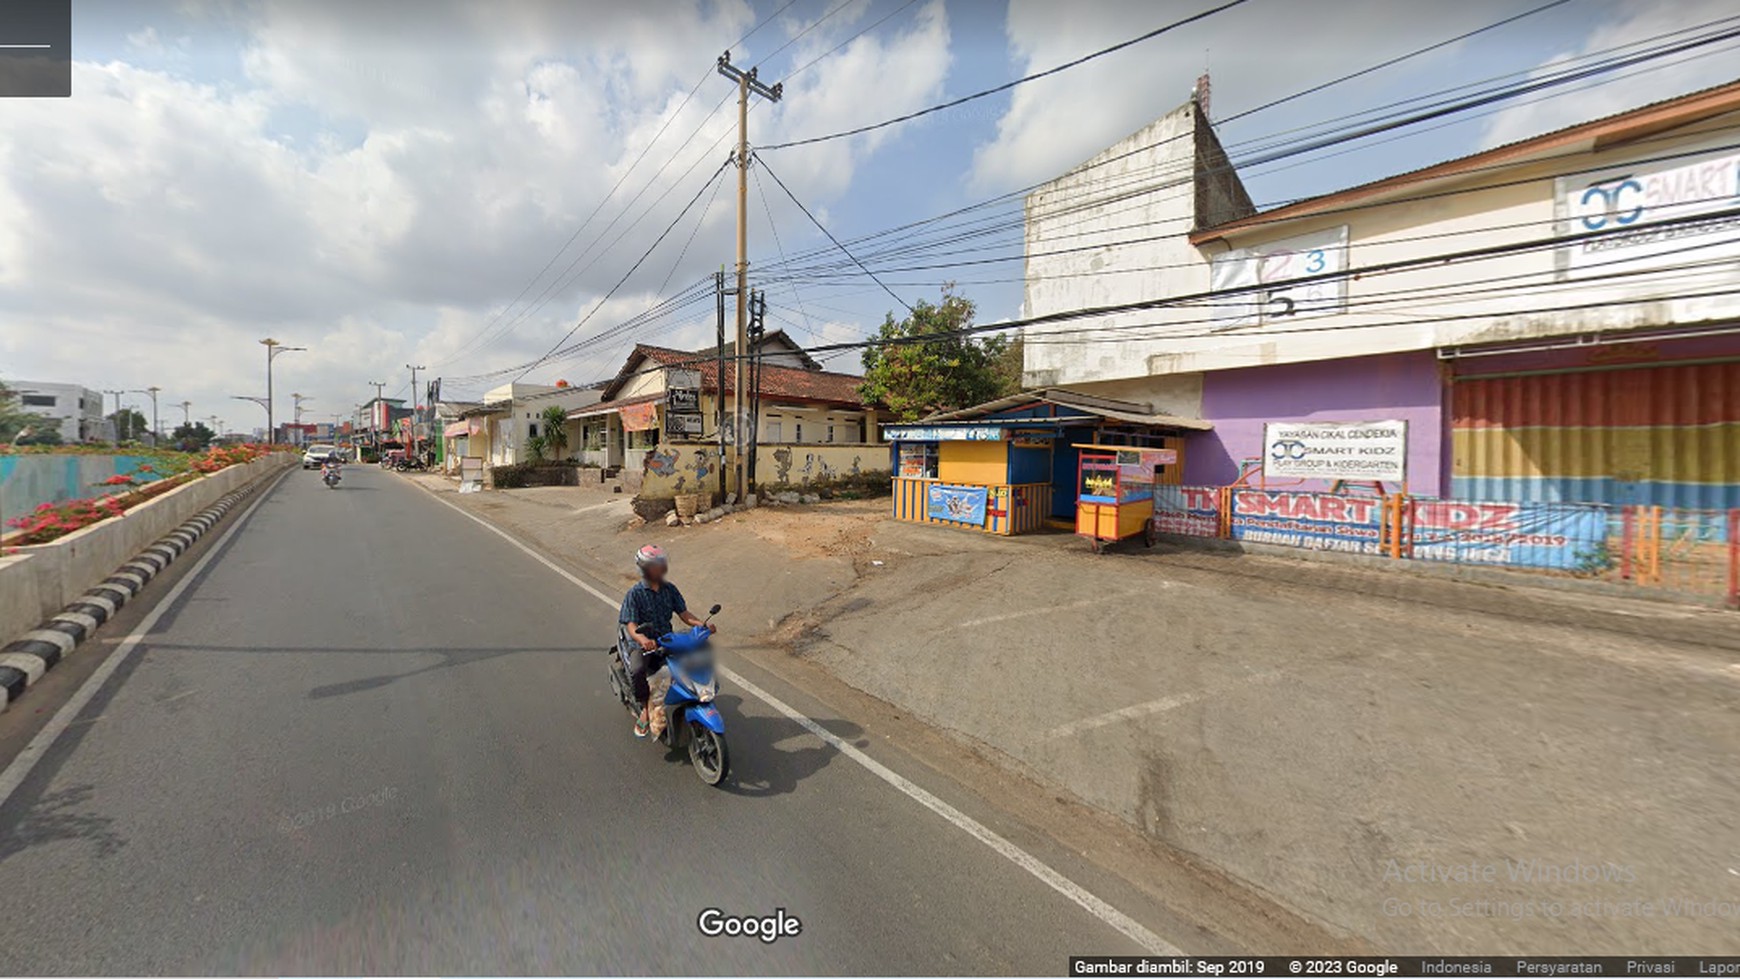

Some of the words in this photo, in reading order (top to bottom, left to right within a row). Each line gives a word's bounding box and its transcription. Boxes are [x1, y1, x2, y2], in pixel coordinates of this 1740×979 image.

[1306, 249, 1326, 273] 3
[1267, 287, 1296, 318] 5
[1279, 430, 1318, 439] YAYASAN
[1304, 447, 1354, 455] SMART
[1358, 447, 1397, 455] KIDZ
[1296, 460, 1325, 468] GROUP
[1235, 490, 1376, 524] SMART
